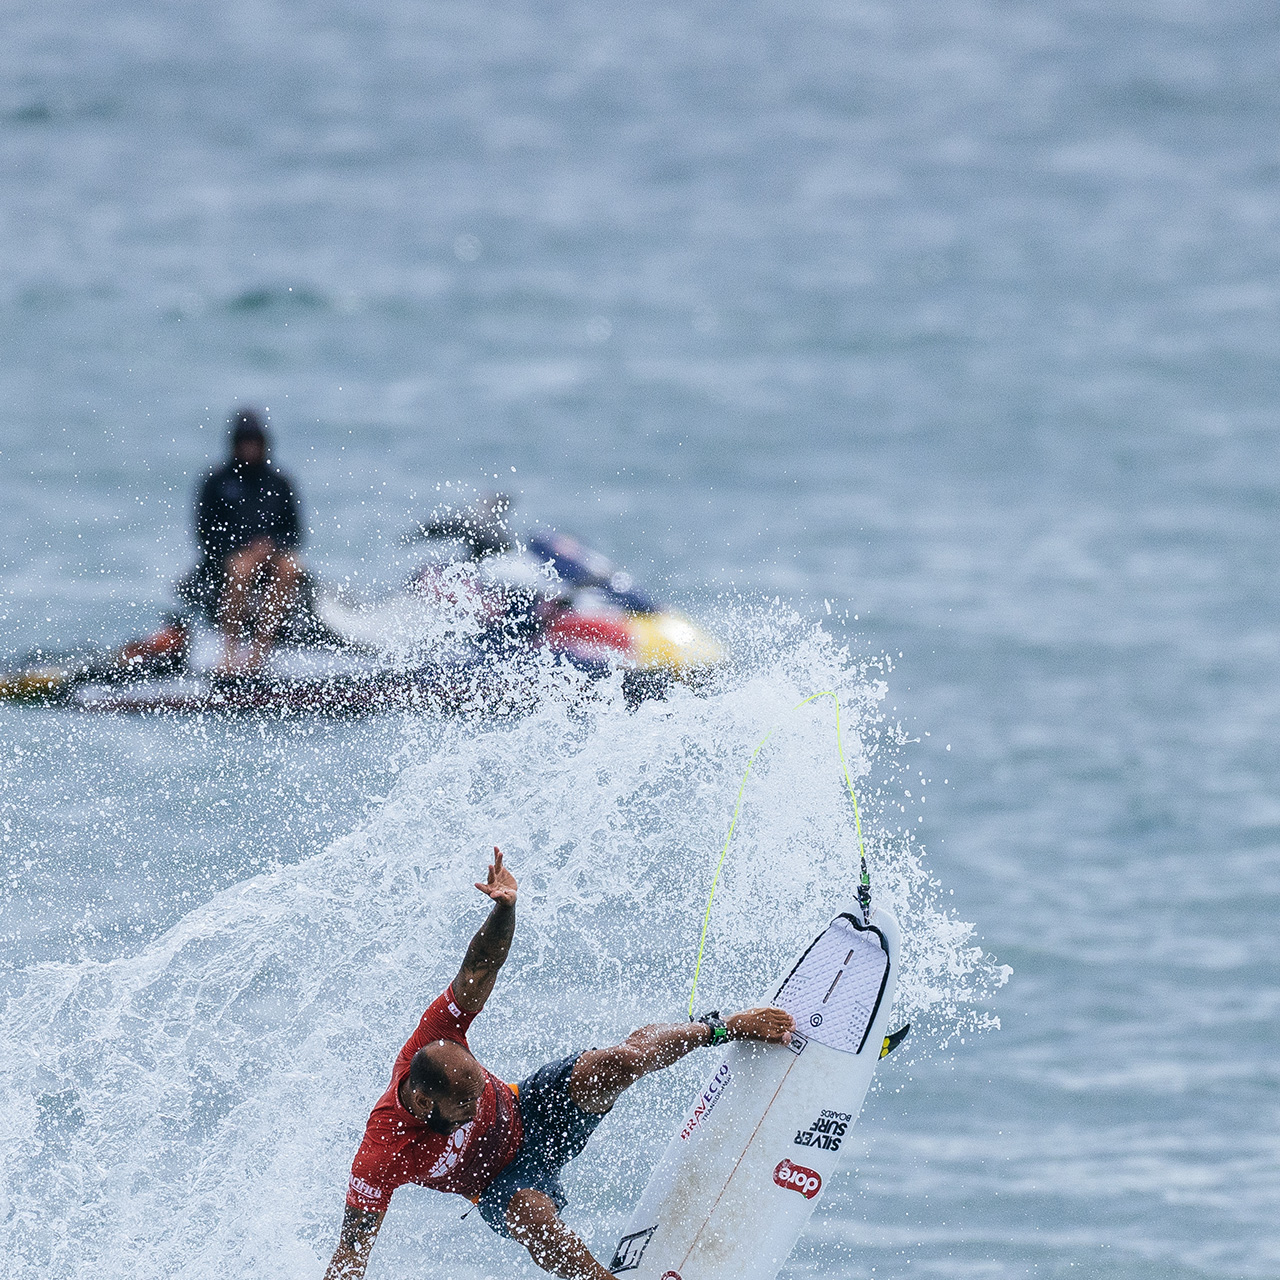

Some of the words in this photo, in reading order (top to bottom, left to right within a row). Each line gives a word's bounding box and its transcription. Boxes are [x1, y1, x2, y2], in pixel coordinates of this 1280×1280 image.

[680, 1063, 729, 1140] BRAVECTO
[820, 1109, 852, 1122] BOARDS
[809, 1117, 848, 1137] SURF
[793, 1130, 842, 1151] SILVER
[778, 1167, 819, 1193] dore
